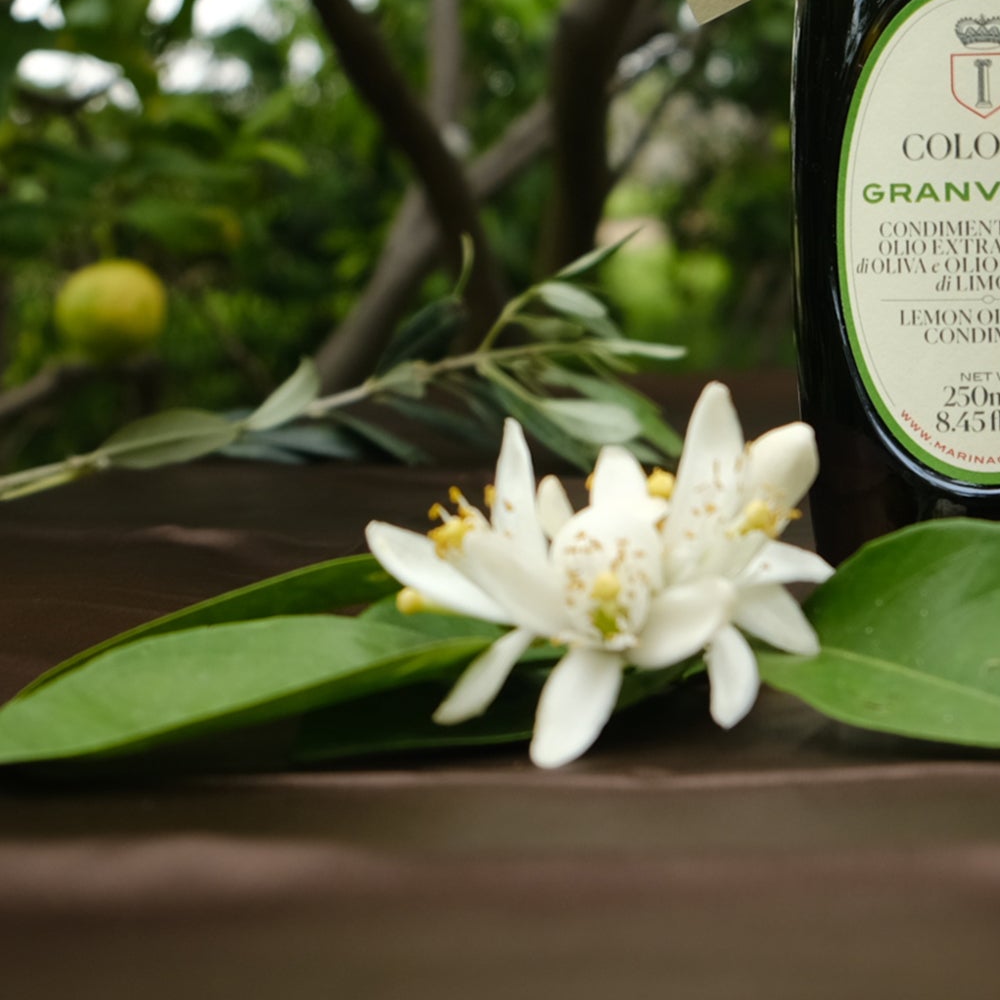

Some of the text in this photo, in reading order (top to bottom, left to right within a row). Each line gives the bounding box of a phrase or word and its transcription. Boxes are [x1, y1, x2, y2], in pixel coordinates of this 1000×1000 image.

[879, 239, 927, 256] OLIO
[856, 258, 869, 274] di
[871, 257, 927, 274] OLIVA
[931, 262, 940, 274] e
[945, 256, 999, 274] OLIO
[935, 275, 952, 292] di
[900, 309, 973, 326] LEMON
[960, 372, 992, 382] NET
[936, 410, 986, 433] 8.45
